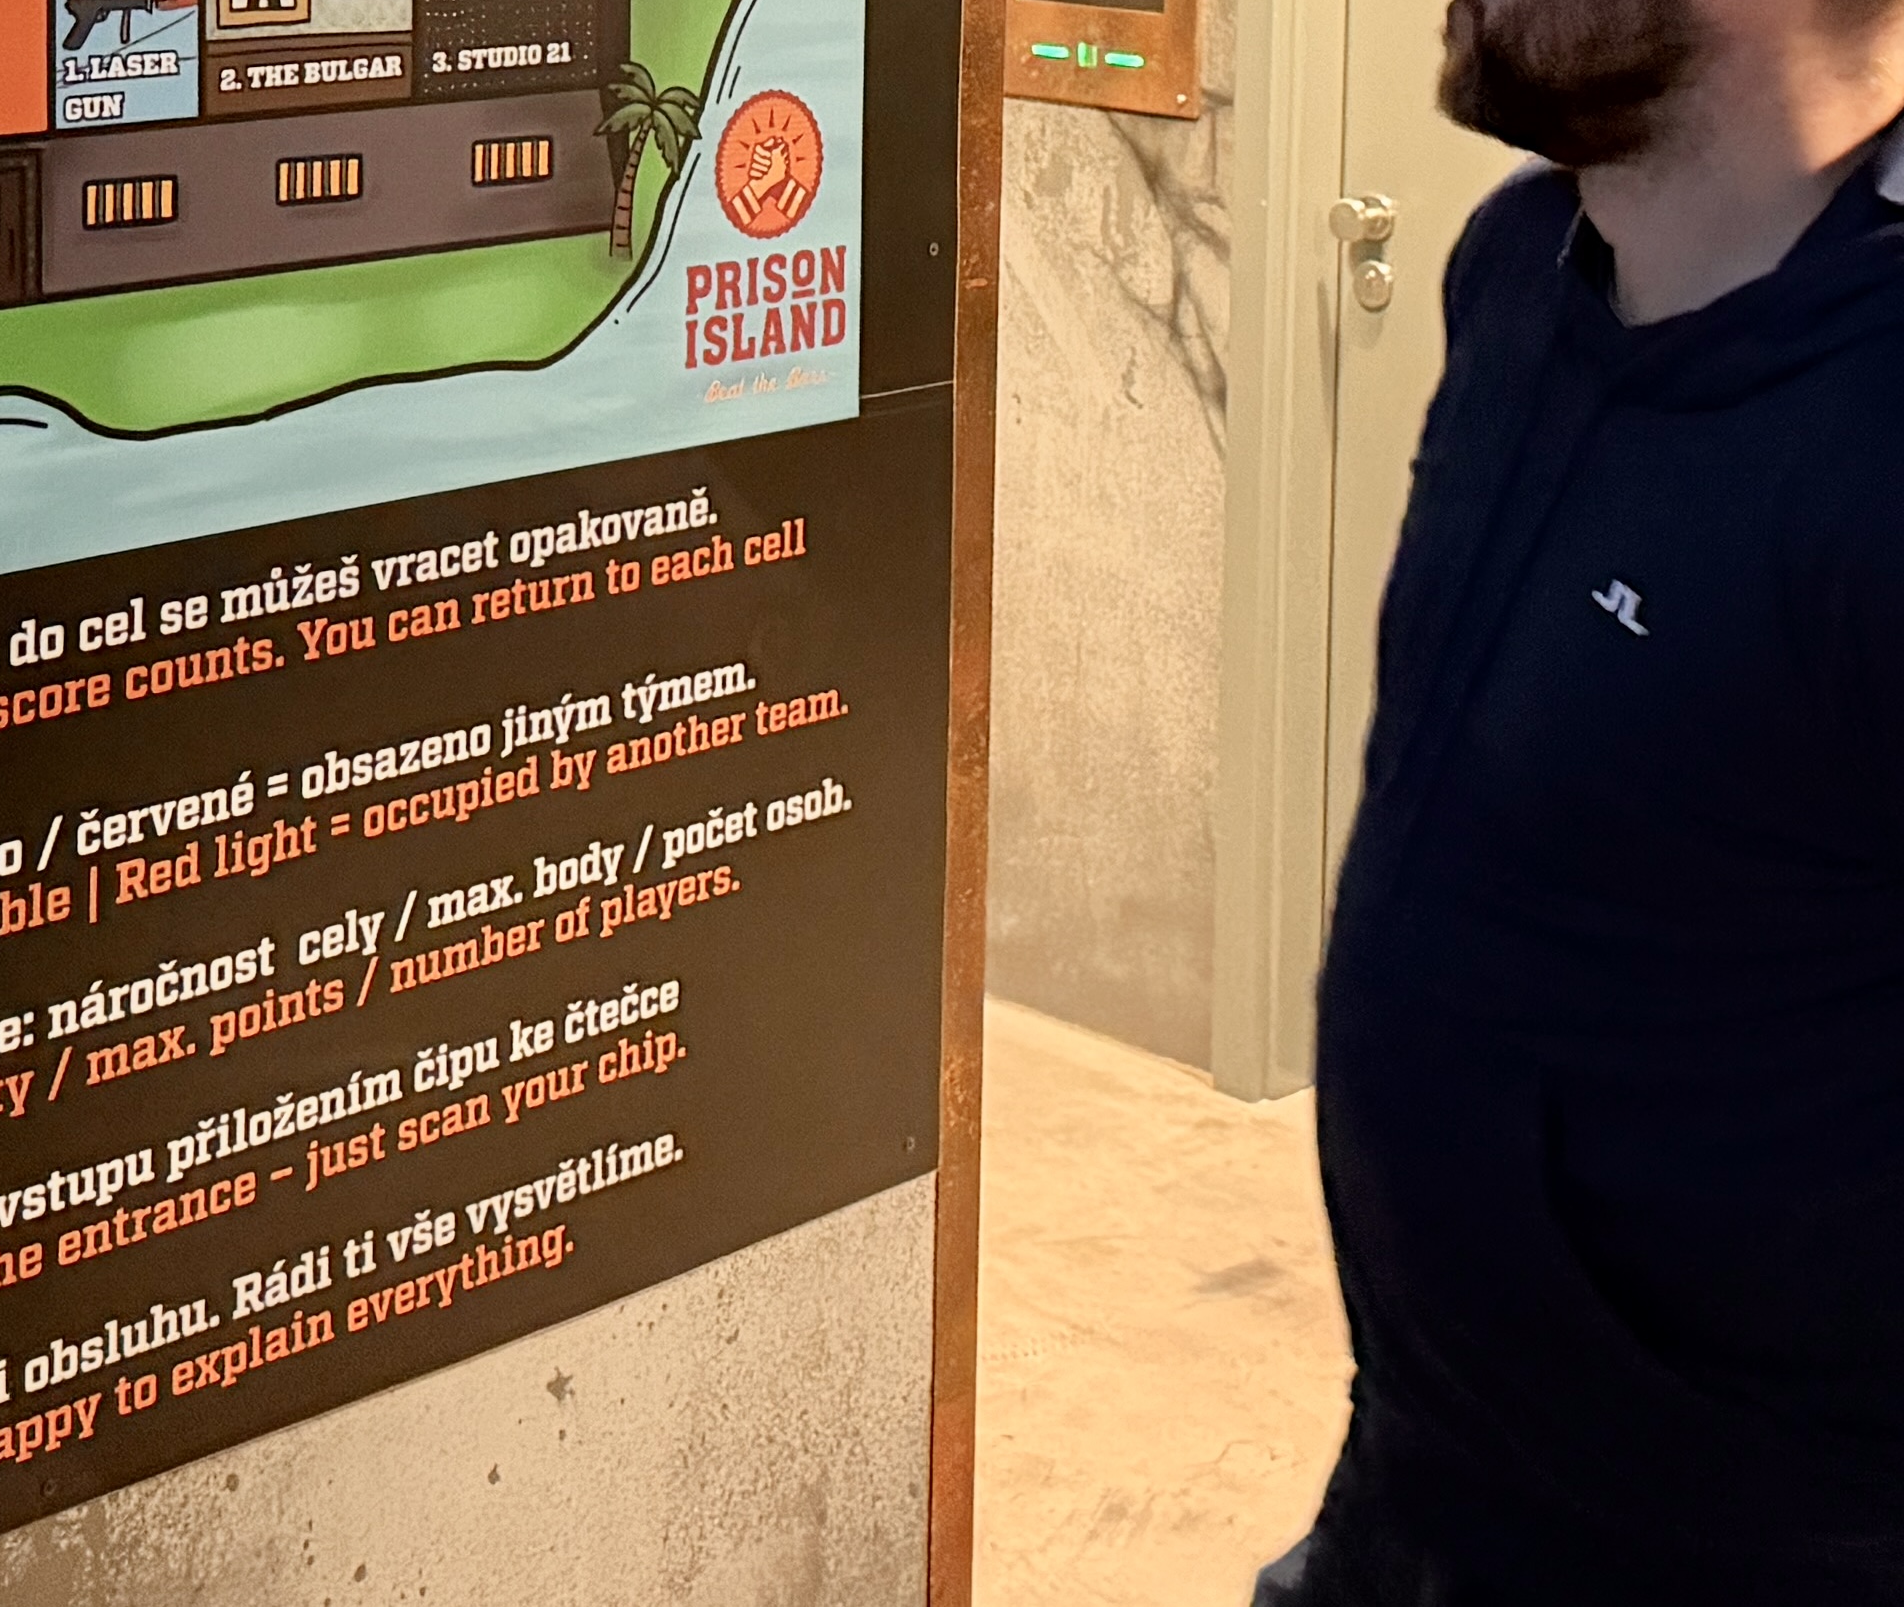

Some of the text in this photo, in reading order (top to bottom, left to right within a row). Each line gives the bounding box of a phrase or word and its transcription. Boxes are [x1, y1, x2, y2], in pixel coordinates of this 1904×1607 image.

[63, 50, 179, 83] 1. LASER
[64, 93, 124, 122] GUN
[220, 55, 404, 92] 2. THE BULGAR
[432, 41, 573, 75] 3. STUDIO 21
[683, 297, 848, 371] ISLAND
[685, 244, 848, 318] PRISON
[9, 618, 65, 667] do
[79, 597, 147, 652] cel
[159, 595, 209, 636] se
[220, 553, 360, 631] můžeš
[370, 530, 500, 591] vracet
[509, 486, 718, 568] opakovaně.
[125, 636, 285, 700] counts.
[296, 616, 377, 661] You
[388, 598, 462, 643] can
[470, 570, 596, 625] return
[604, 558, 641, 595] to
[650, 534, 735, 586] each
[743, 517, 807, 567] cell
[76, 769, 262, 856] červené
[301, 723, 492, 804] obsazeno
[500, 692, 613, 763] jiným
[620, 662, 757, 725] týmem.
[114, 840, 202, 905] Red
[213, 815, 318, 878] light
[363, 751, 541, 838] occupied
[549, 748, 598, 791] by
[605, 711, 747, 775] another
[754, 688, 849, 737] team.
[47, 936, 276, 1048] náročnost
[298, 908, 386, 966] cely
[426, 874, 525, 929] max.
[532, 840, 625, 899] body
[661, 801, 759, 877] počet
[766, 777, 853, 832] osob.
[85, 1025, 197, 1086] max.
[208, 978, 345, 1058] points
[389, 918, 547, 994] number
[554, 895, 592, 944] of
[599, 865, 745, 939] players.
[57, 1171, 257, 1266] entrance
[304, 1121, 387, 1193] just
[397, 1093, 492, 1152] scan
[500, 1059, 590, 1126] your
[597, 1028, 688, 1086] chip.
[165, 1068, 402, 1184] přiložením
[413, 1036, 501, 1093] čipu
[508, 1019, 555, 1063] ke
[564, 979, 680, 1049] čtečce
[24, 1298, 221, 1393] obsluhu.
[231, 1244, 333, 1321] Rádi
[342, 1229, 377, 1279] ti
[385, 1208, 456, 1263] vše
[464, 1133, 684, 1240] vysvětlíme.
[113, 1373, 158, 1416] to
[171, 1308, 336, 1396] explain
[346, 1223, 575, 1333] everything.
